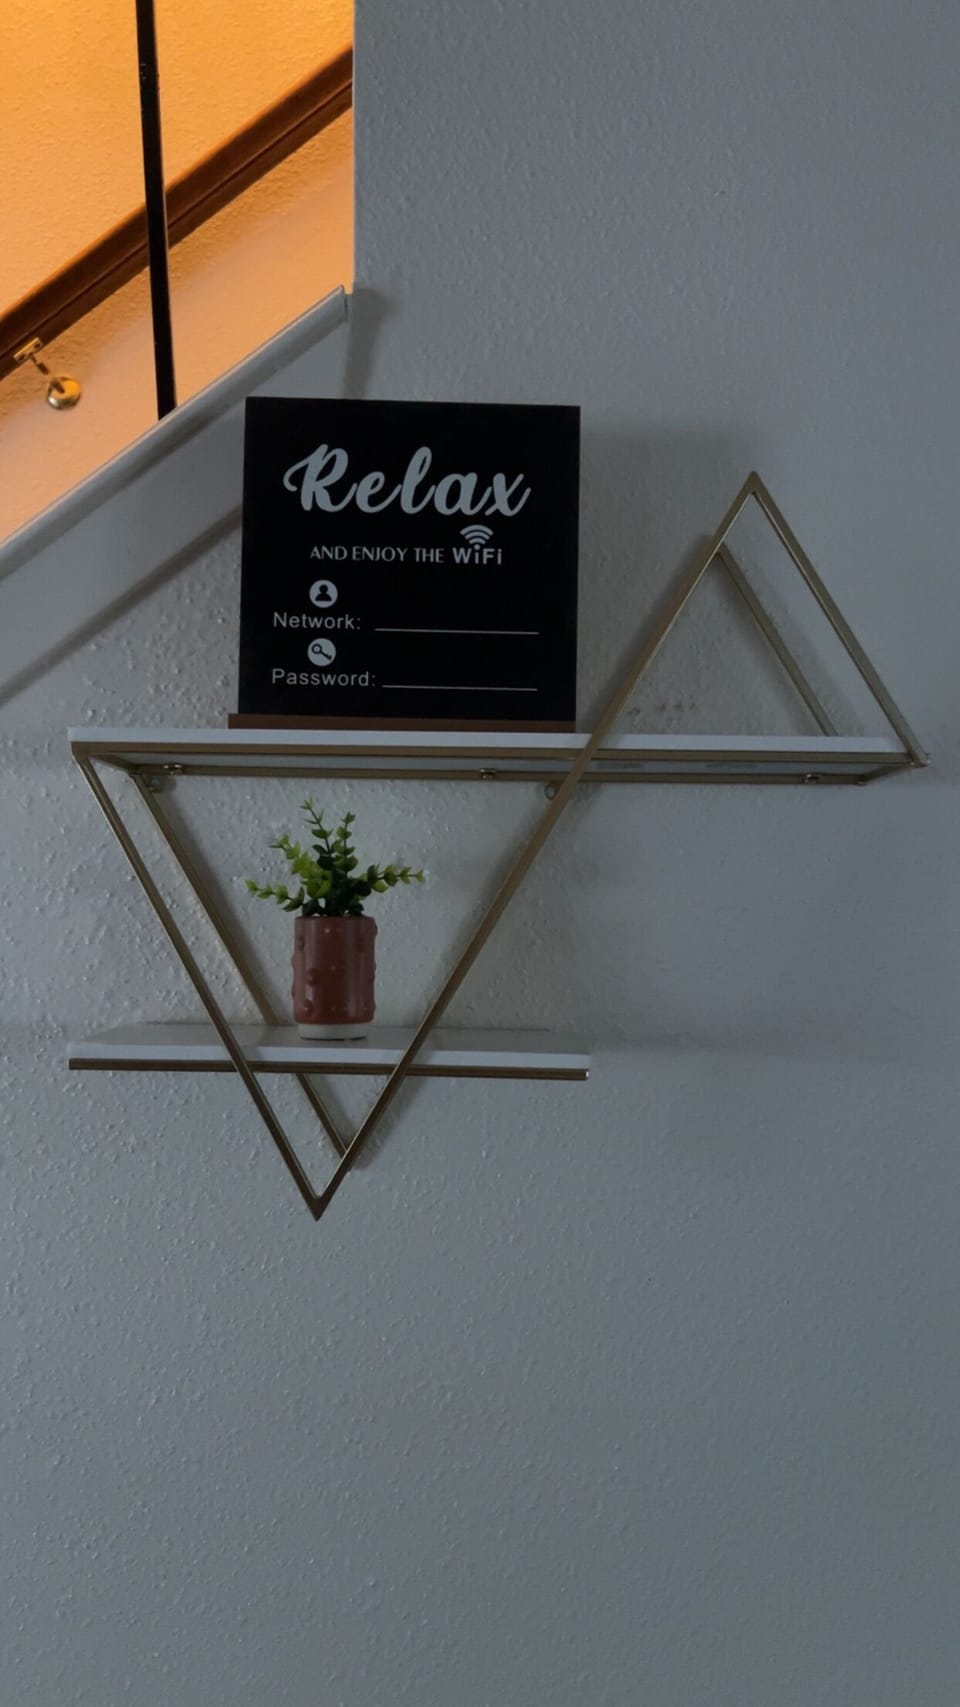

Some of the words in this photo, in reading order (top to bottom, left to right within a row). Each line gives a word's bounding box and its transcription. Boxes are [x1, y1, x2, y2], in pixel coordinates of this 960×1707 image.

[283, 444, 531, 517] Relax
[310, 546, 347, 560] AND
[352, 546, 407, 561] ENJOY
[414, 547, 444, 563] THE
[452, 544, 502, 564] WiFi
[273, 612, 360, 629] Network:
[272, 668, 375, 686] Password:
